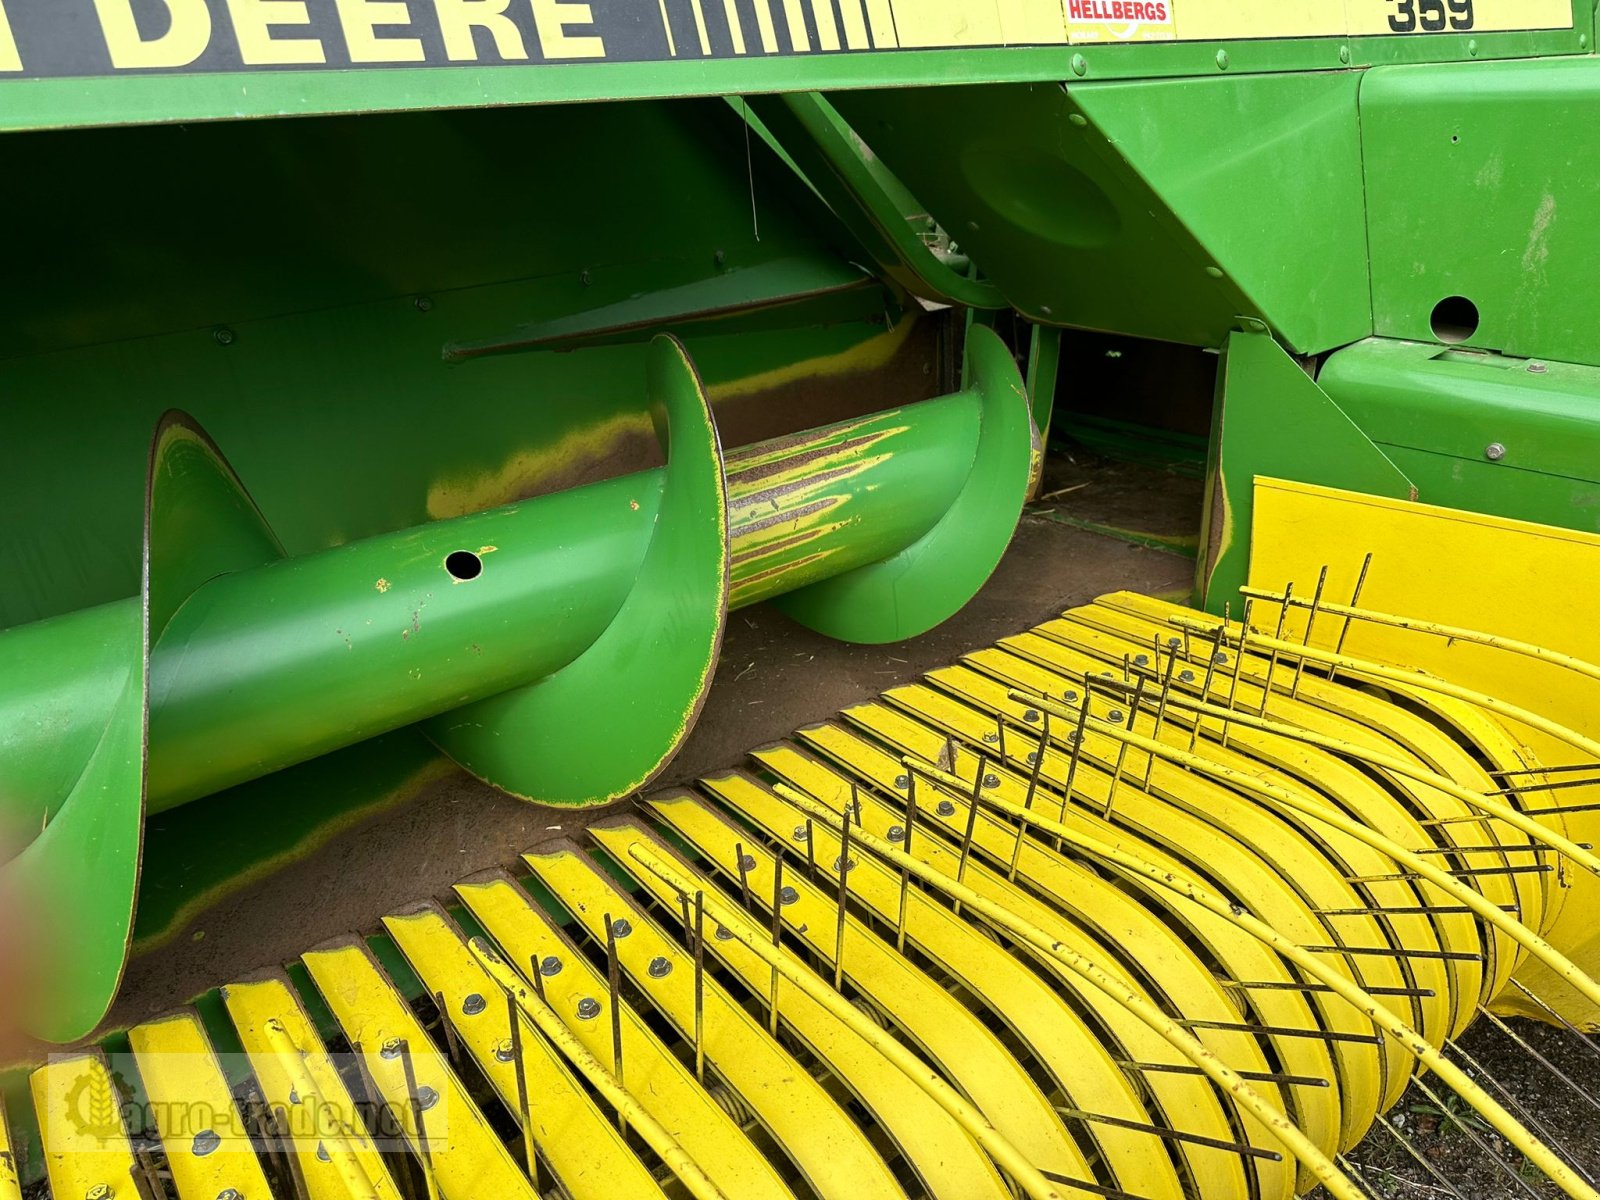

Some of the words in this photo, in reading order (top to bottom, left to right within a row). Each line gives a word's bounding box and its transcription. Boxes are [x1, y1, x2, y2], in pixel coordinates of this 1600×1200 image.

[1069, 0, 1167, 21] HELLBERGS
[1386, 0, 1474, 32] 359
[93, 0, 606, 69] DEERE
